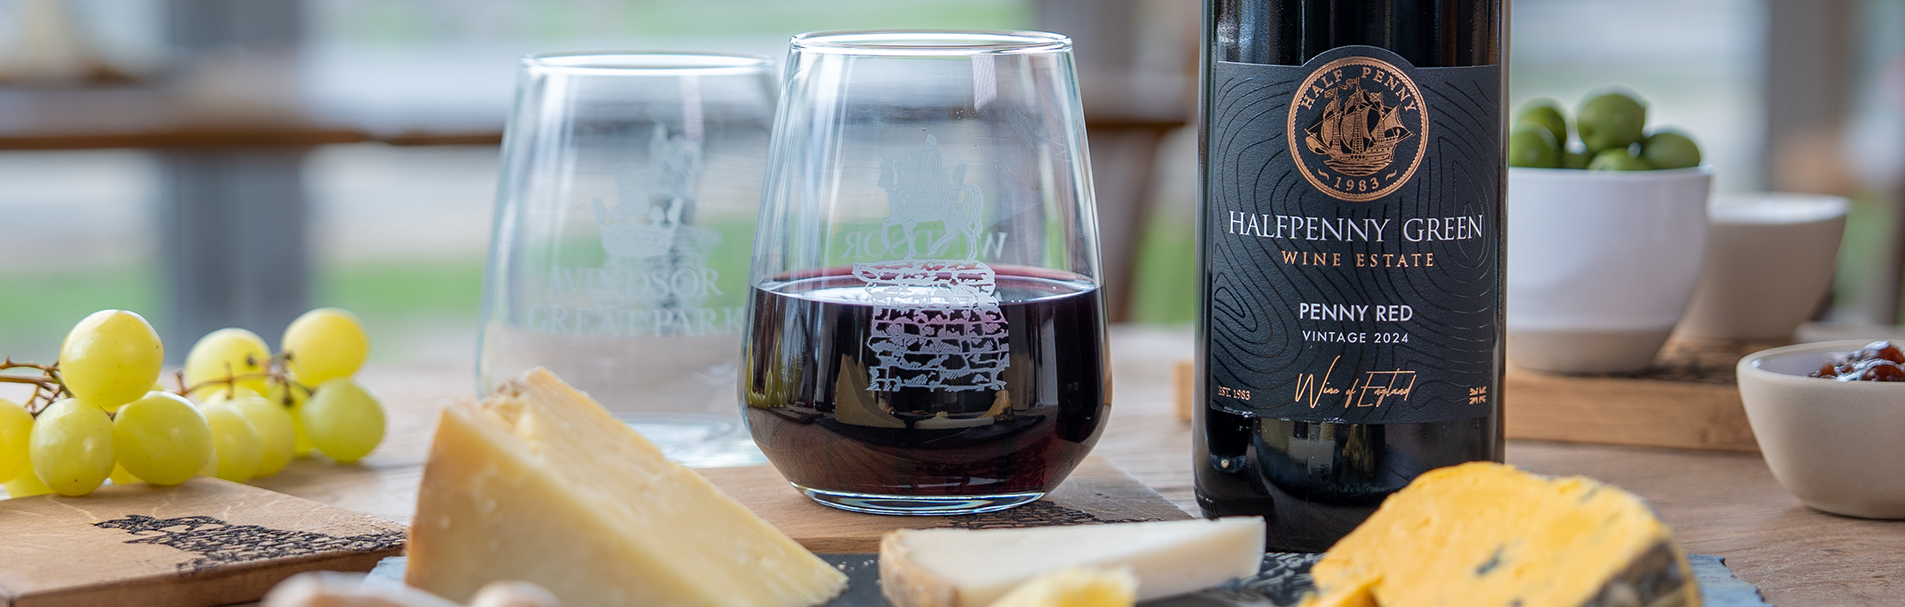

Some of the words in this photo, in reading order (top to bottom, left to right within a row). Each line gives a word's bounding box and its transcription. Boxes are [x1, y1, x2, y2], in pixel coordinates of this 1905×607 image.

[1300, 69, 1343, 110] HALF
[1361, 66, 1417, 112] PENNY
[1334, 177, 1379, 192] 1983
[1229, 210, 1391, 242] HALFPENNY
[1403, 214, 1484, 242] GREEN
[1281, 250, 1341, 266] WINE
[1356, 253, 1434, 268] ESTATE
[551, 265, 725, 298] WINDSOR
[527, 302, 646, 337] GREAT
[651, 304, 745, 337] PARK
[1299, 302, 1369, 321] PENNY
[1376, 305, 1413, 321] RED
[1302, 330, 1366, 343] VINTAGE
[1374, 332, 1409, 344] 2024
[1295, 355, 1340, 409] Wine
[1344, 378, 1359, 409] of
[1357, 368, 1416, 408] England
[1233, 389, 1251, 401] 1983
